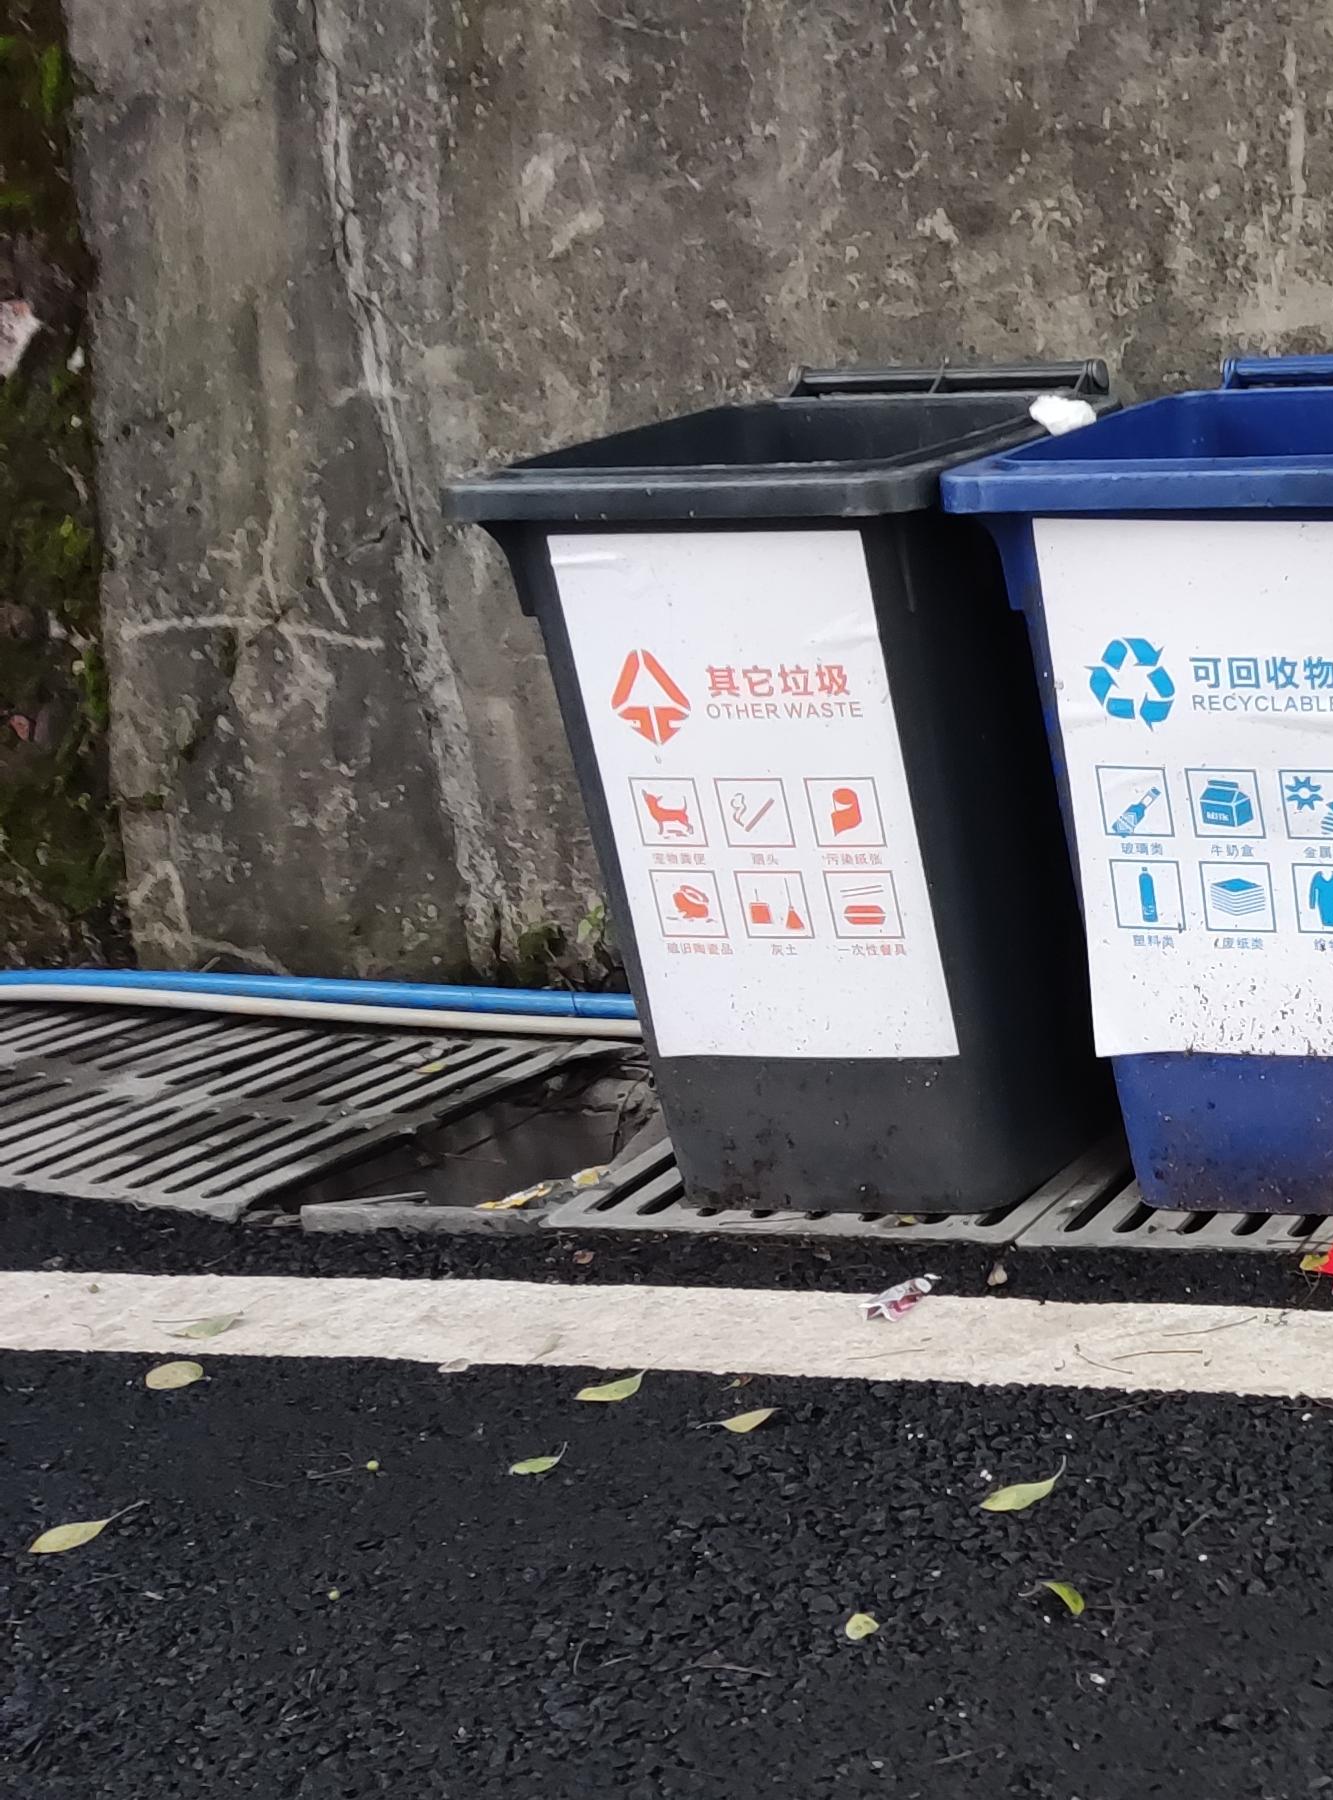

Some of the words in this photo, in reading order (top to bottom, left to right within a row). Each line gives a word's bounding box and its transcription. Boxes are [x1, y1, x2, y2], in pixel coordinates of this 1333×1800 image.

[706, 664, 851, 698] 其它垃圾
[706, 703, 781, 719] OTHER
[782, 702, 864, 718] WASTE
[1121, 842, 1163, 856] 玻璃类
[1211, 844, 1254, 858] 牛奶盒
[1133, 935, 1175, 948] 塑料类
[1222, 937, 1264, 950] 废纸类
[771, 943, 799, 956] 灰土
[838, 943, 907, 956] 一次性餐具
